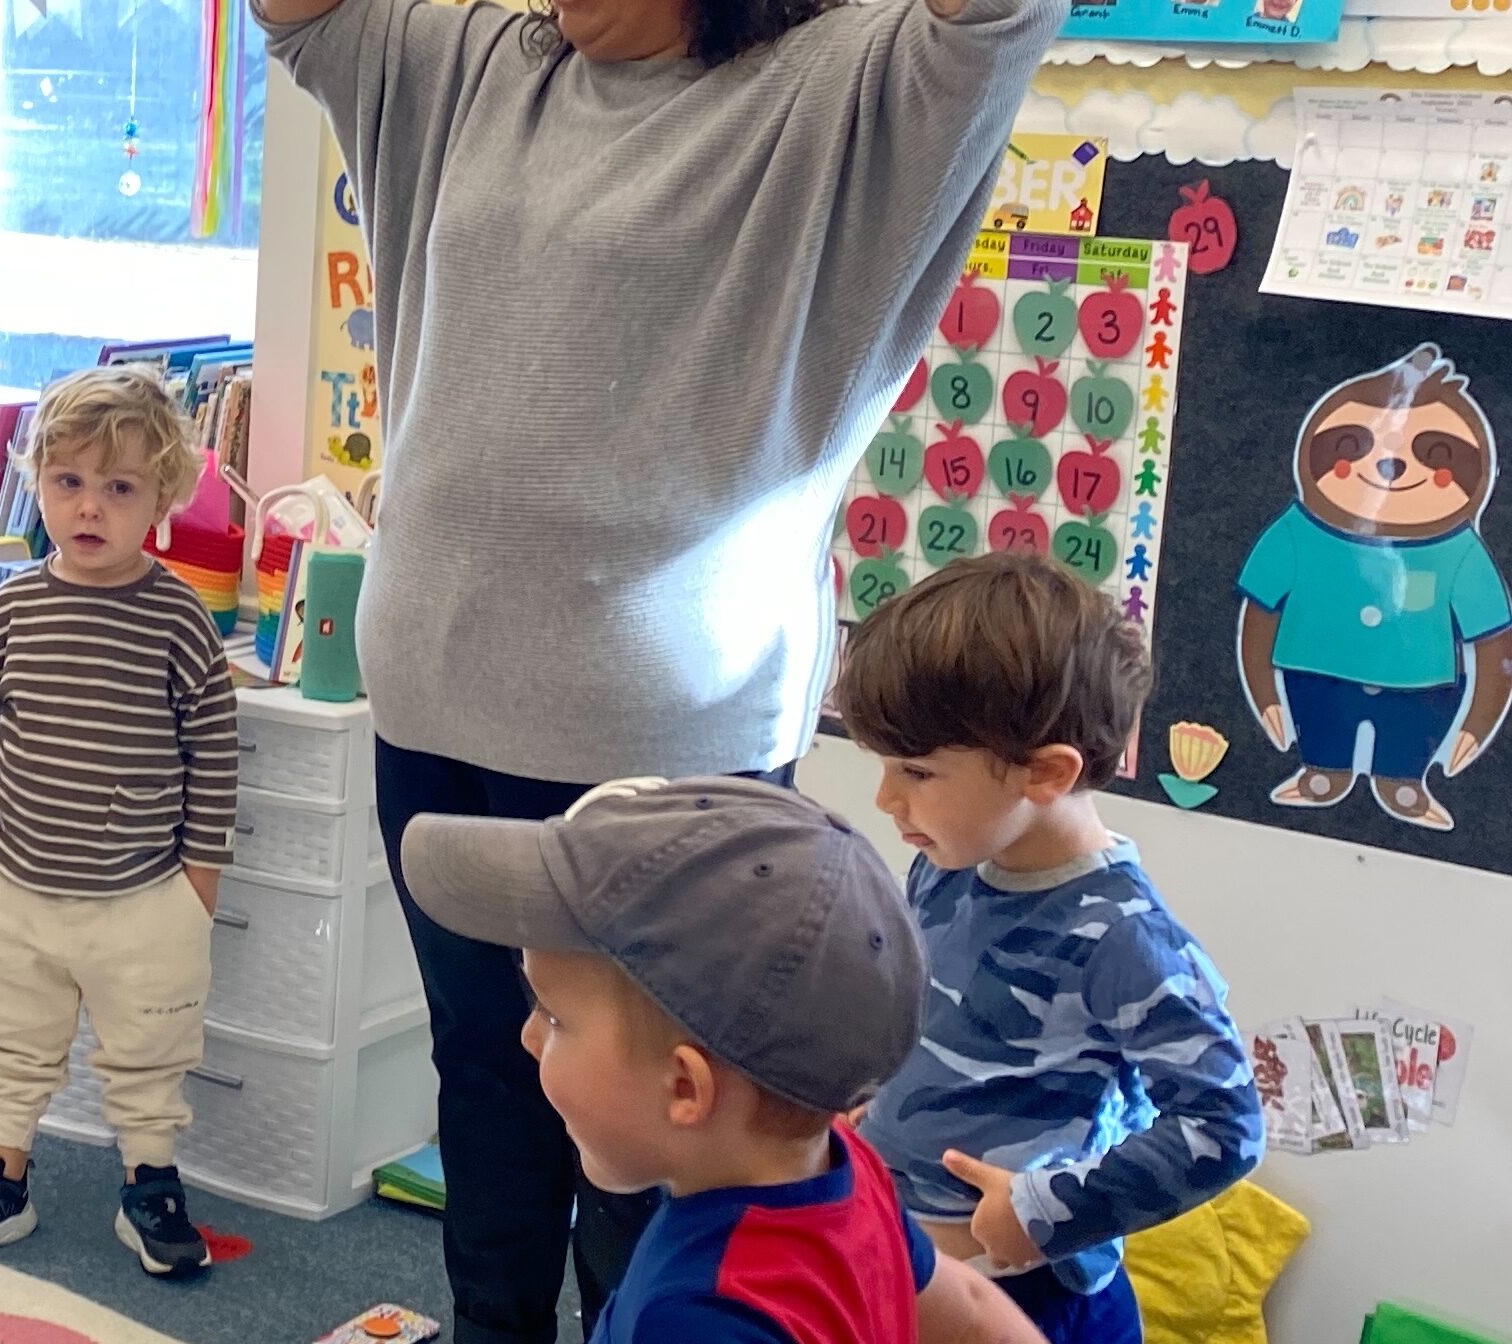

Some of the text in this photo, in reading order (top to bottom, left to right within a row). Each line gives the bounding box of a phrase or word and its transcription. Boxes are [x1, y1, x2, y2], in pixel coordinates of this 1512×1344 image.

[1023, 238, 1149, 262] Friday Saturday
[1184, 217, 1223, 255] 29
[1035, 312, 1055, 342] 2
[1098, 310, 1120, 344] 3
[950, 376, 971, 409] 8
[1022, 389, 1039, 427] 9
[1086, 392, 1114, 424] 10
[879, 448, 905, 479] 14
[942, 457, 970, 487] 15
[1005, 457, 1037, 486] 16
[1073, 468, 1101, 501] 17
[858, 514, 886, 544] 21
[927, 521, 966, 553] 22
[1064, 536, 1101, 572] 24
[1392, 1017, 1438, 1046] Cycle
